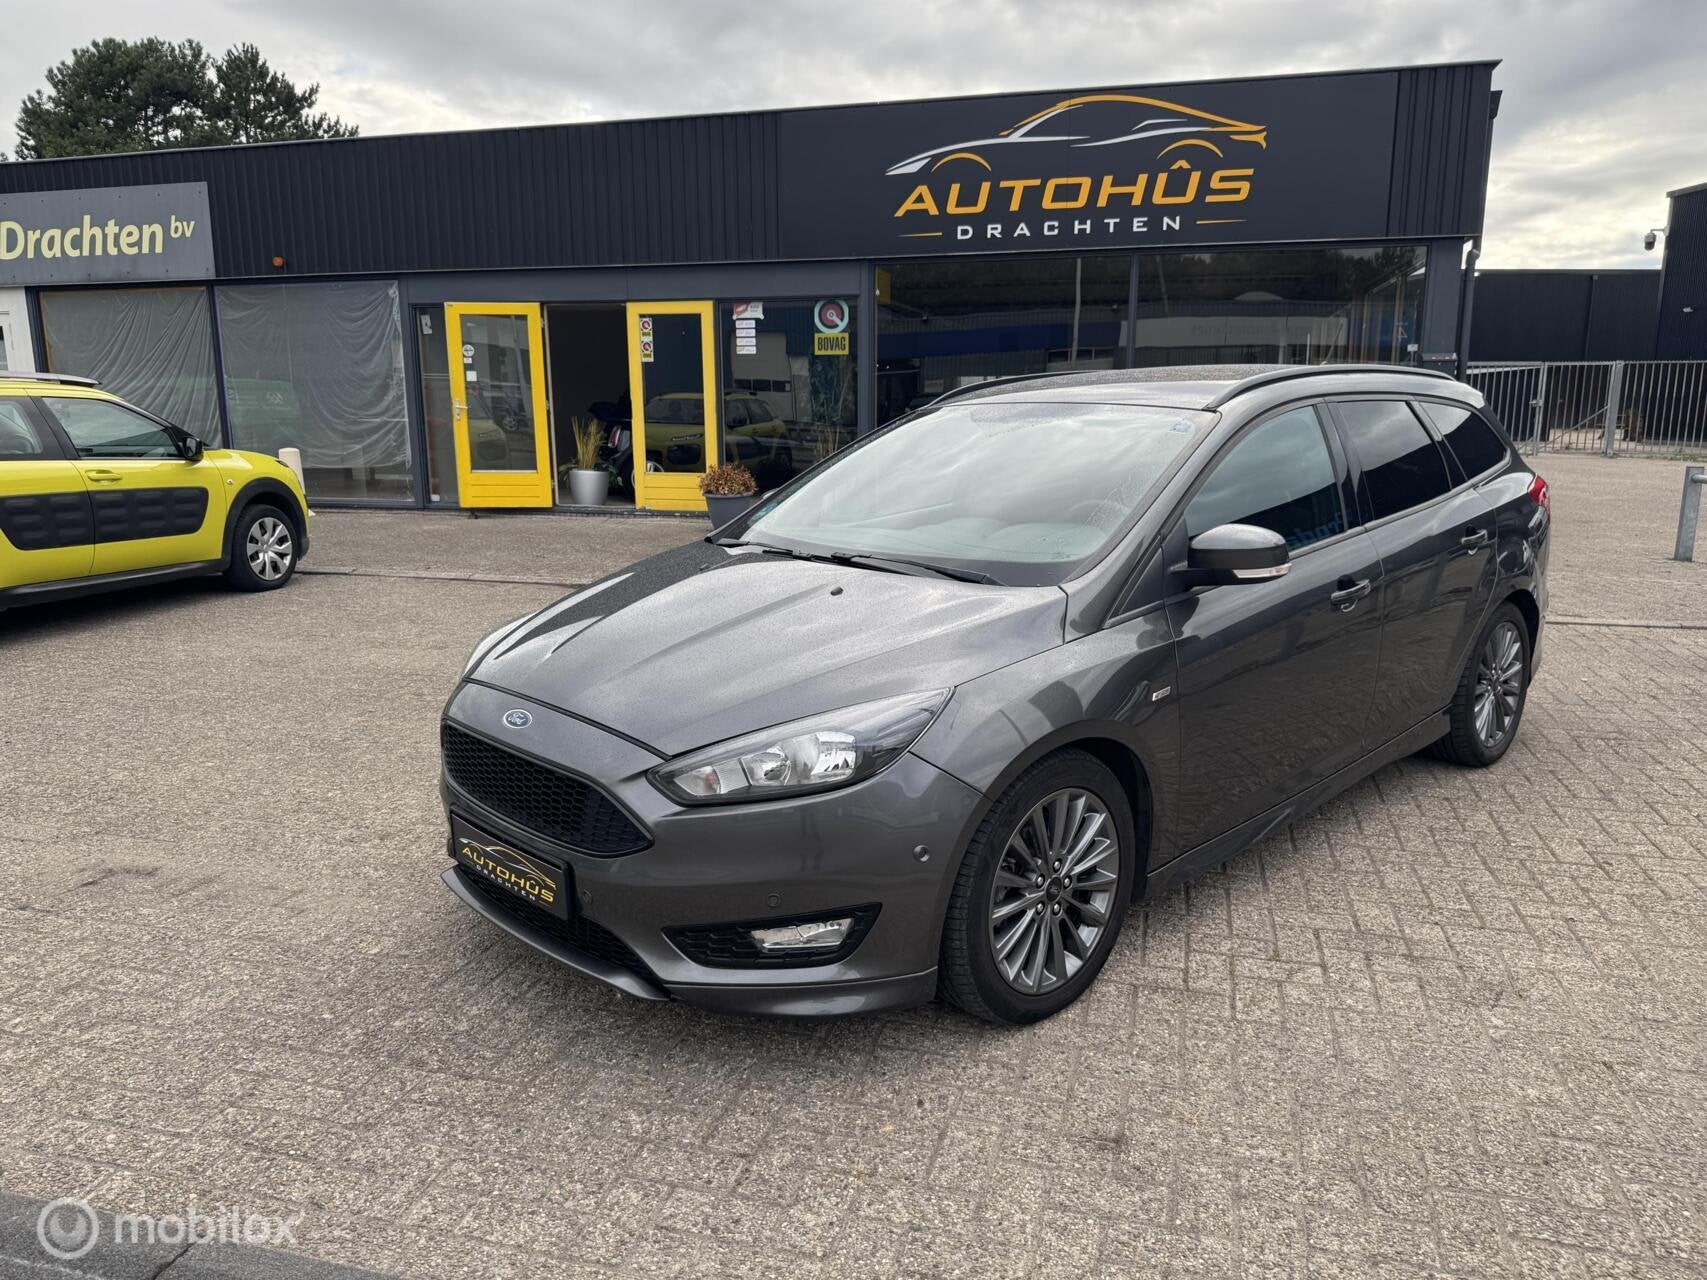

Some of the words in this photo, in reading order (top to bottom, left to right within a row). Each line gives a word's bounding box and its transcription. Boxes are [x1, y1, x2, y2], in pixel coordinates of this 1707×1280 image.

[894, 160, 1254, 217] AUTOHÛS
[0, 215, 163, 260] Drachten
[170, 215, 195, 238] bv
[956, 216, 1181, 240] DRACHTEN
[817, 336, 846, 351] BOVAG
[476, 864, 536, 900] DRACHTEN
